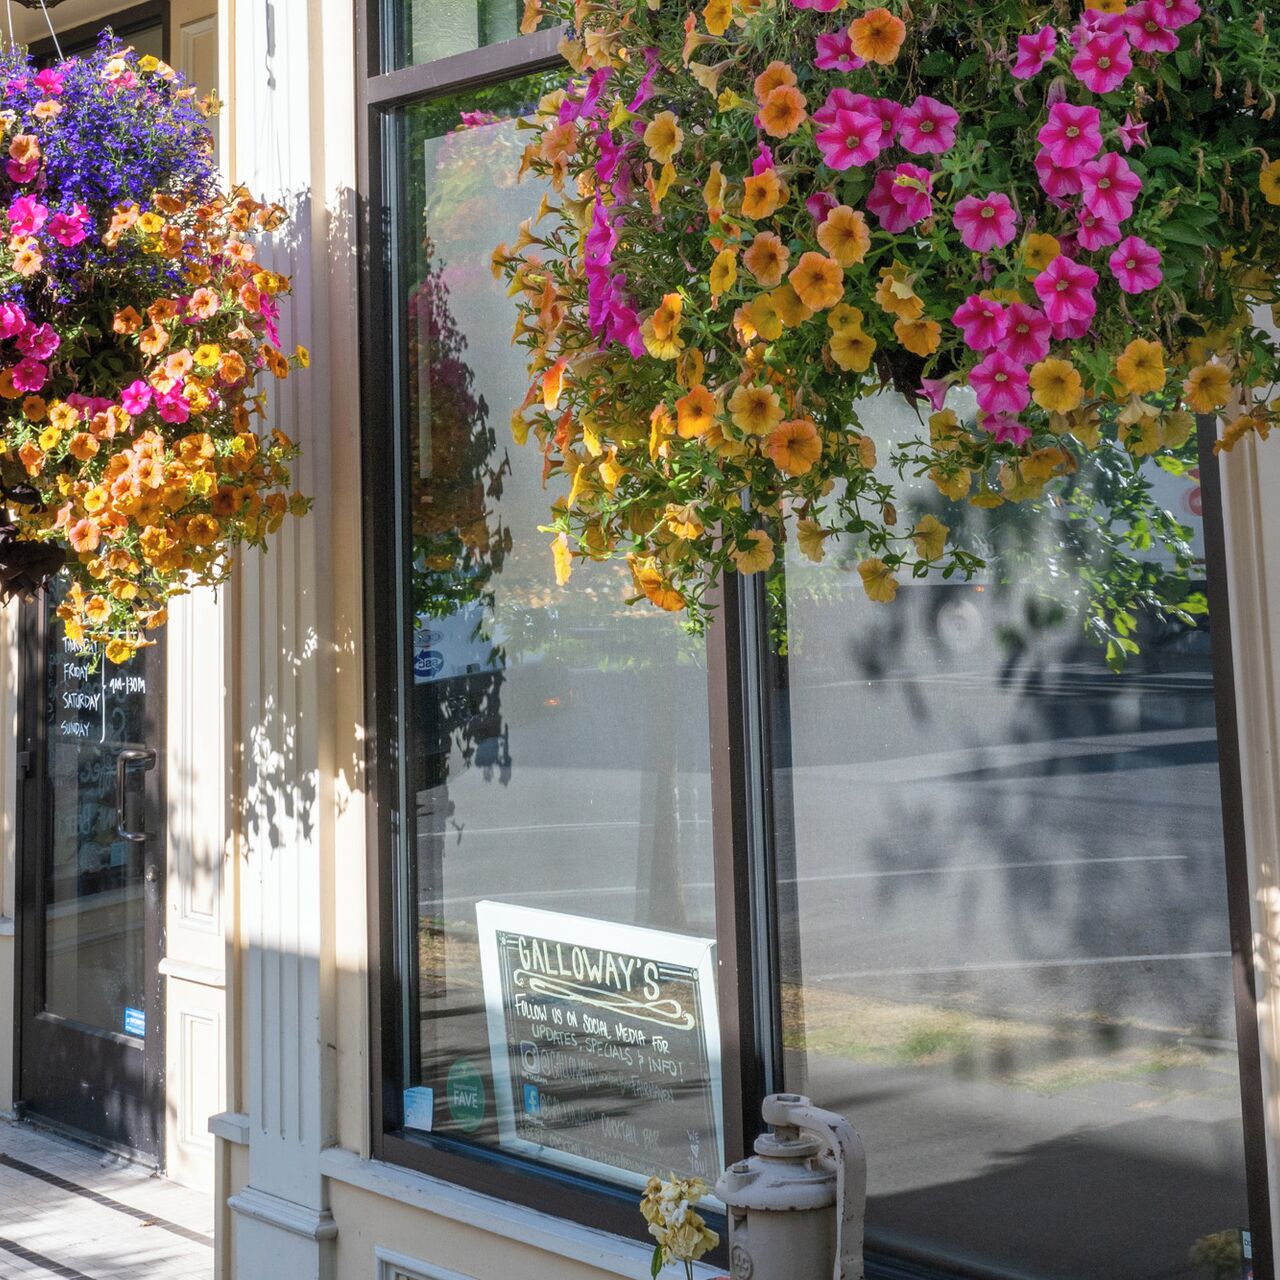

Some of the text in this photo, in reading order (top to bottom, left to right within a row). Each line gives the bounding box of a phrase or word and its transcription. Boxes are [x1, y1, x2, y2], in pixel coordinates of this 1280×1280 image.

[63, 662, 90, 682] FRIDAY
[62, 691, 101, 712] SATURDAY
[60, 720, 91, 737] SUNDAY
[518, 935, 660, 1001] GALLOWAY'S
[514, 993, 670, 1054] FOLLOW US ON SOCIAL MEDIA FOR
[584, 1038, 634, 1066] SPECIALS
[648, 1057, 685, 1083] INFO!
[452, 1090, 479, 1109] FAVE
